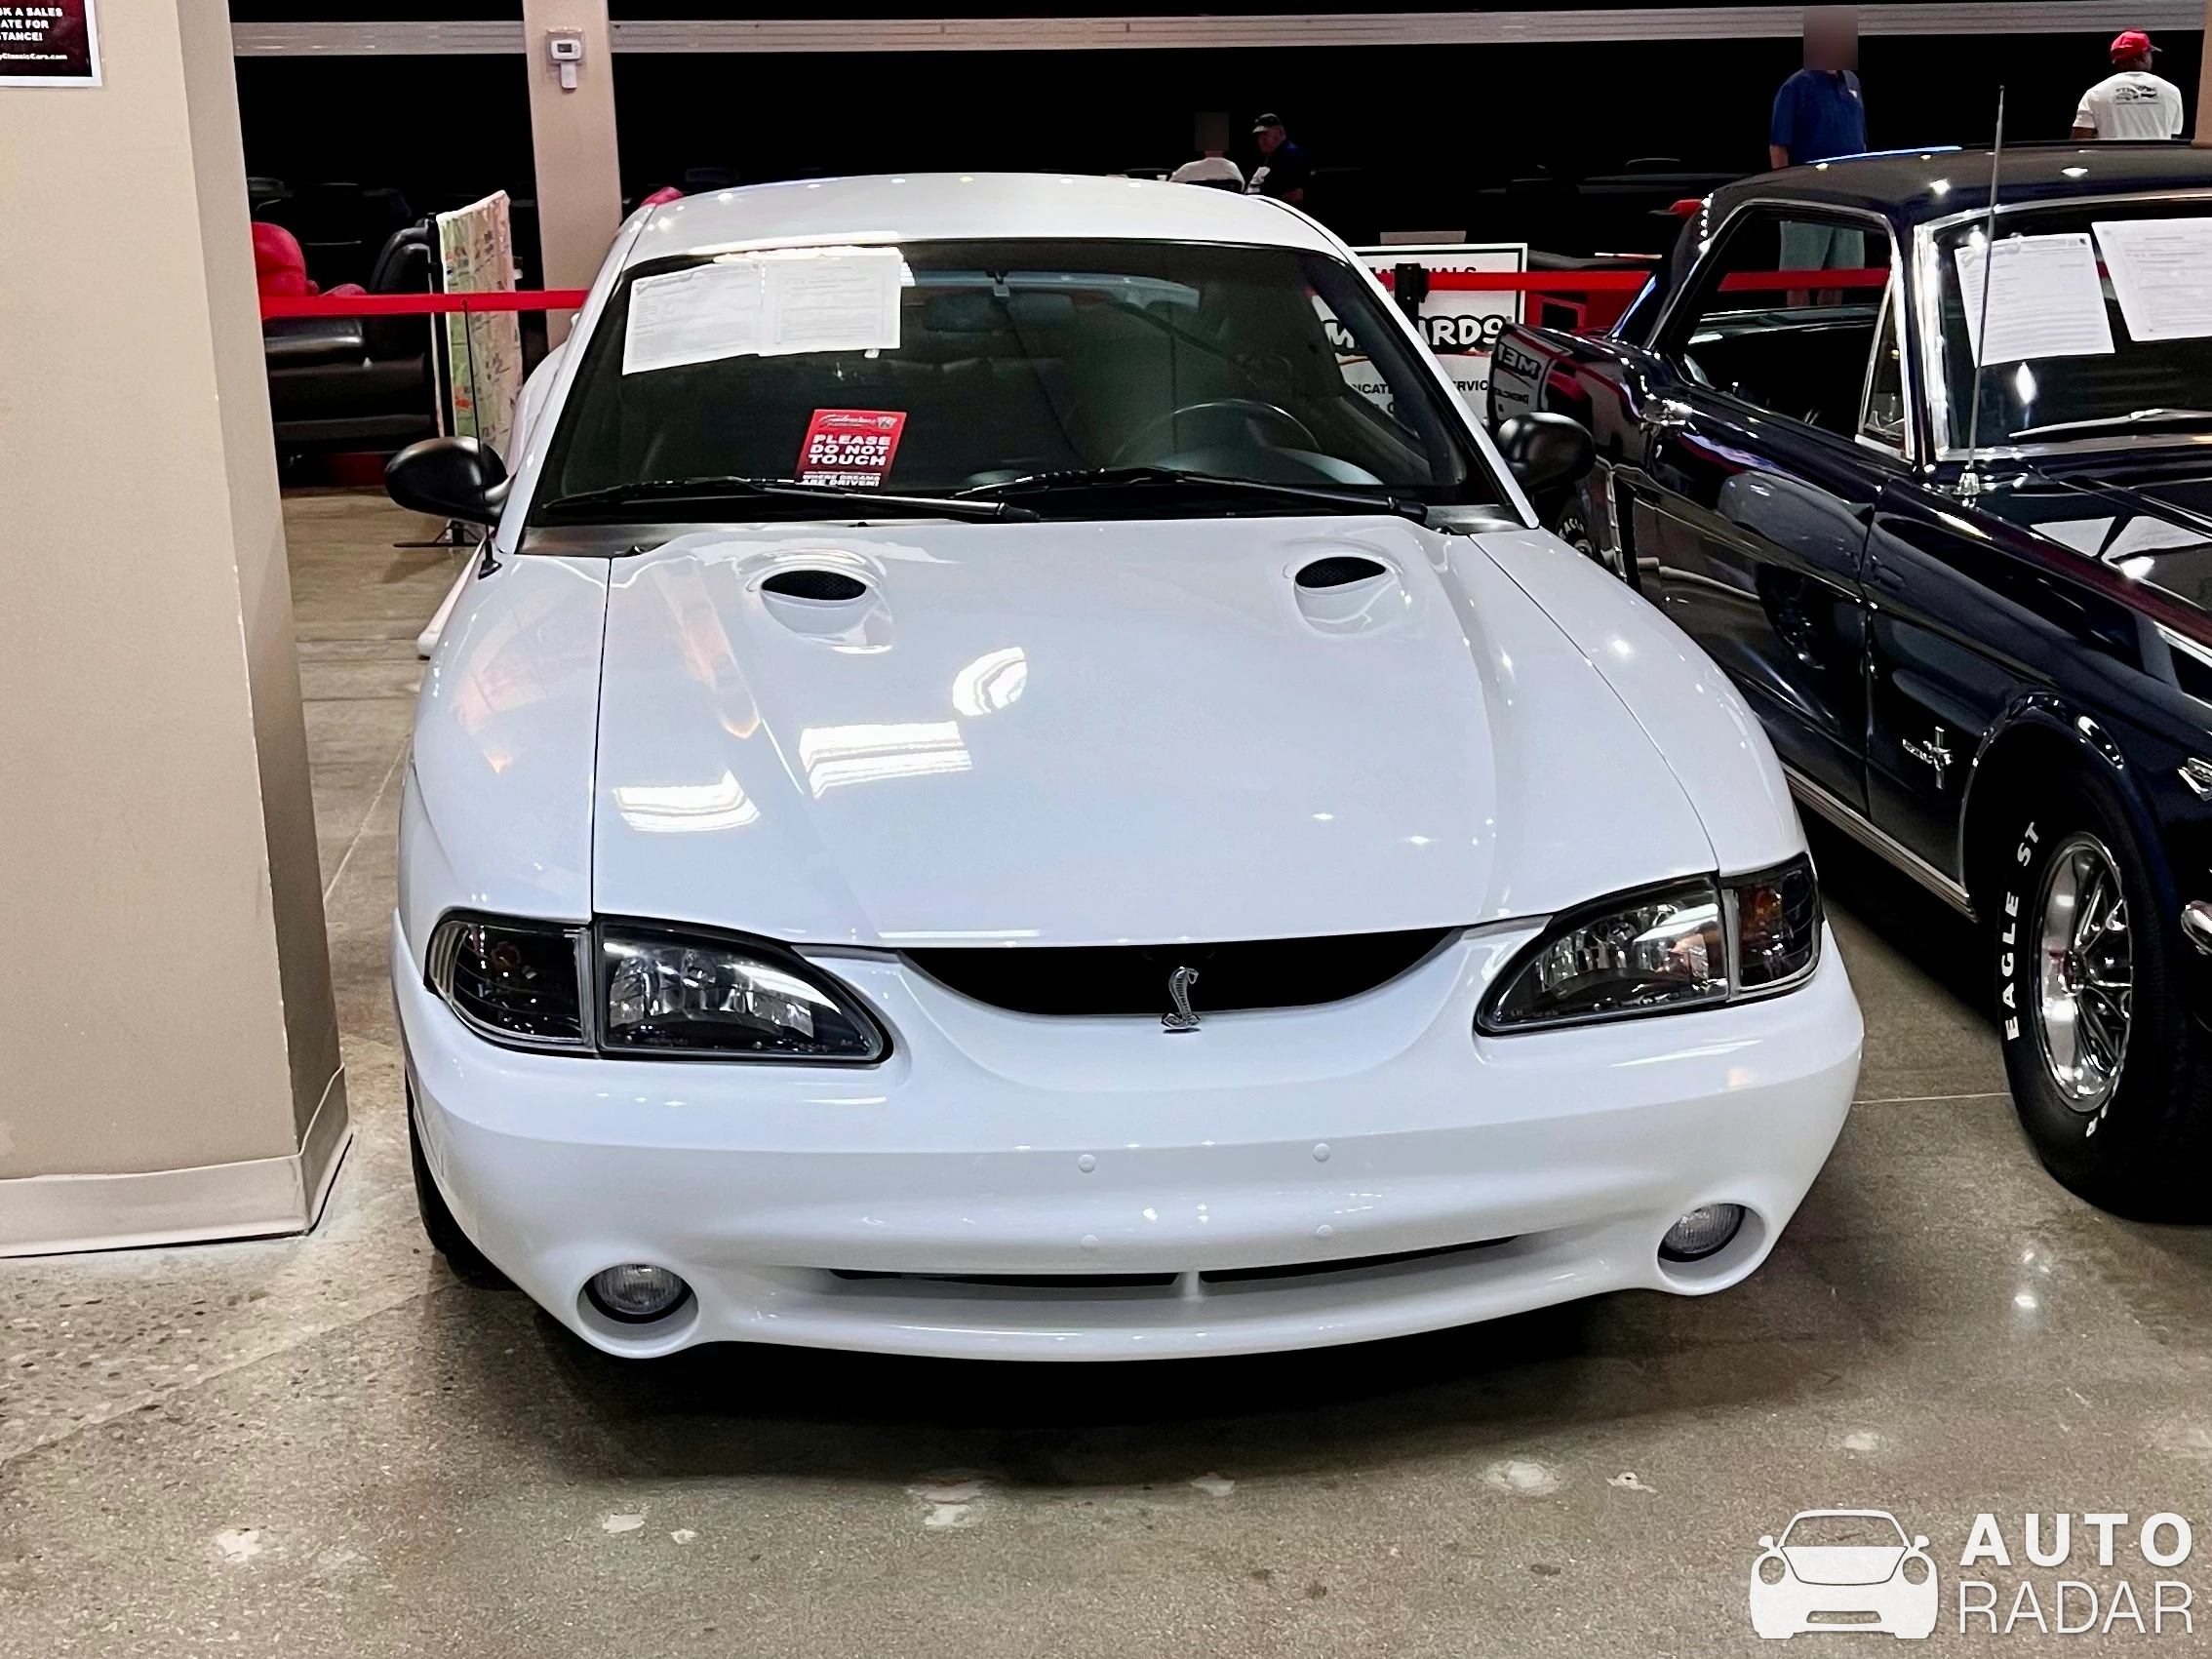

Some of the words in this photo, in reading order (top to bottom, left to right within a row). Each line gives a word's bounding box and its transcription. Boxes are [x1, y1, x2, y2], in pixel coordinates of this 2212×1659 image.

[15, 7, 24, 17] A
[25, 7, 63, 18] SALES
[24, 20, 50, 29] FOR
[0, 31, 43, 42] TANCE!
[812, 434, 892, 446] PLEASE
[810, 444, 840, 454] DO
[845, 445, 889, 455] NOT
[809, 454, 887, 466] TOUCH
[2001, 890, 2020, 1041] EAGLE
[2016, 821, 2039, 867] ST
